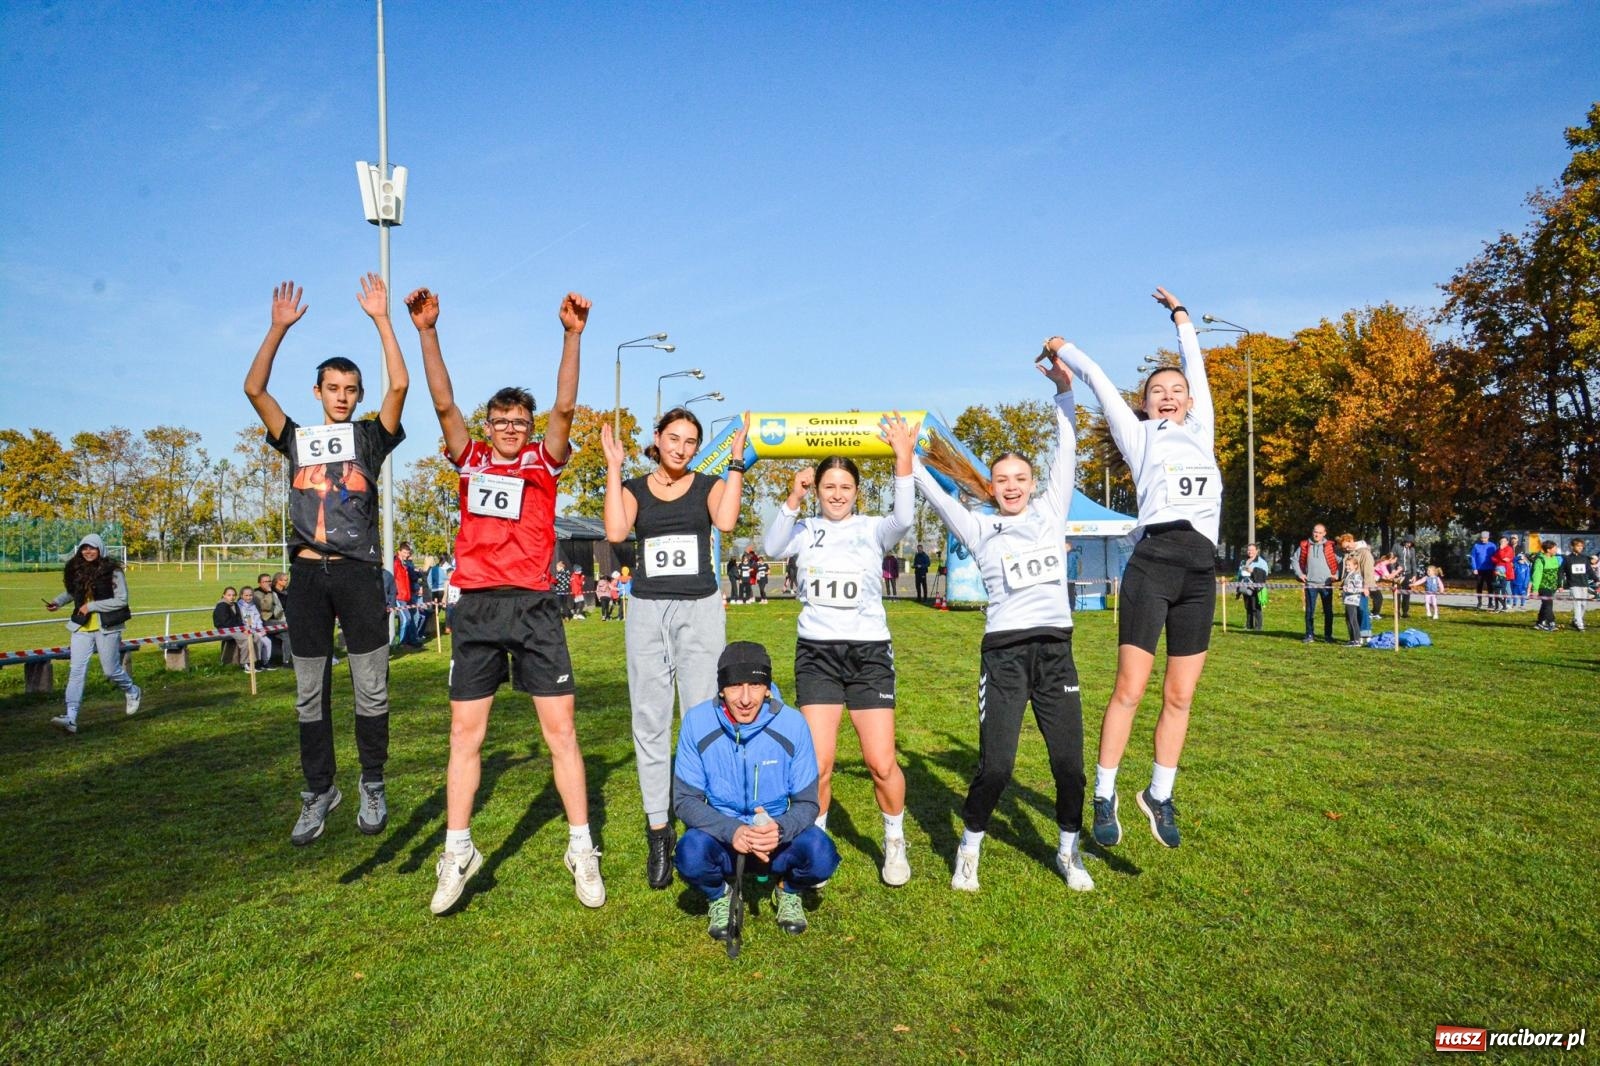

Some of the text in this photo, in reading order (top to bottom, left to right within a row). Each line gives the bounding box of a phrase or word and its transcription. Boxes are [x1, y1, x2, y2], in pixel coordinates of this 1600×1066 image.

[808, 417, 858, 425] Gmina
[309, 437, 343, 457] 96
[806, 438, 861, 447] Wielkie
[1179, 476, 1208, 496] 97
[479, 488, 509, 510] 76
[655, 549, 687, 568] 98
[1009, 555, 1060, 580] 109
[810, 579, 858, 600] 110
